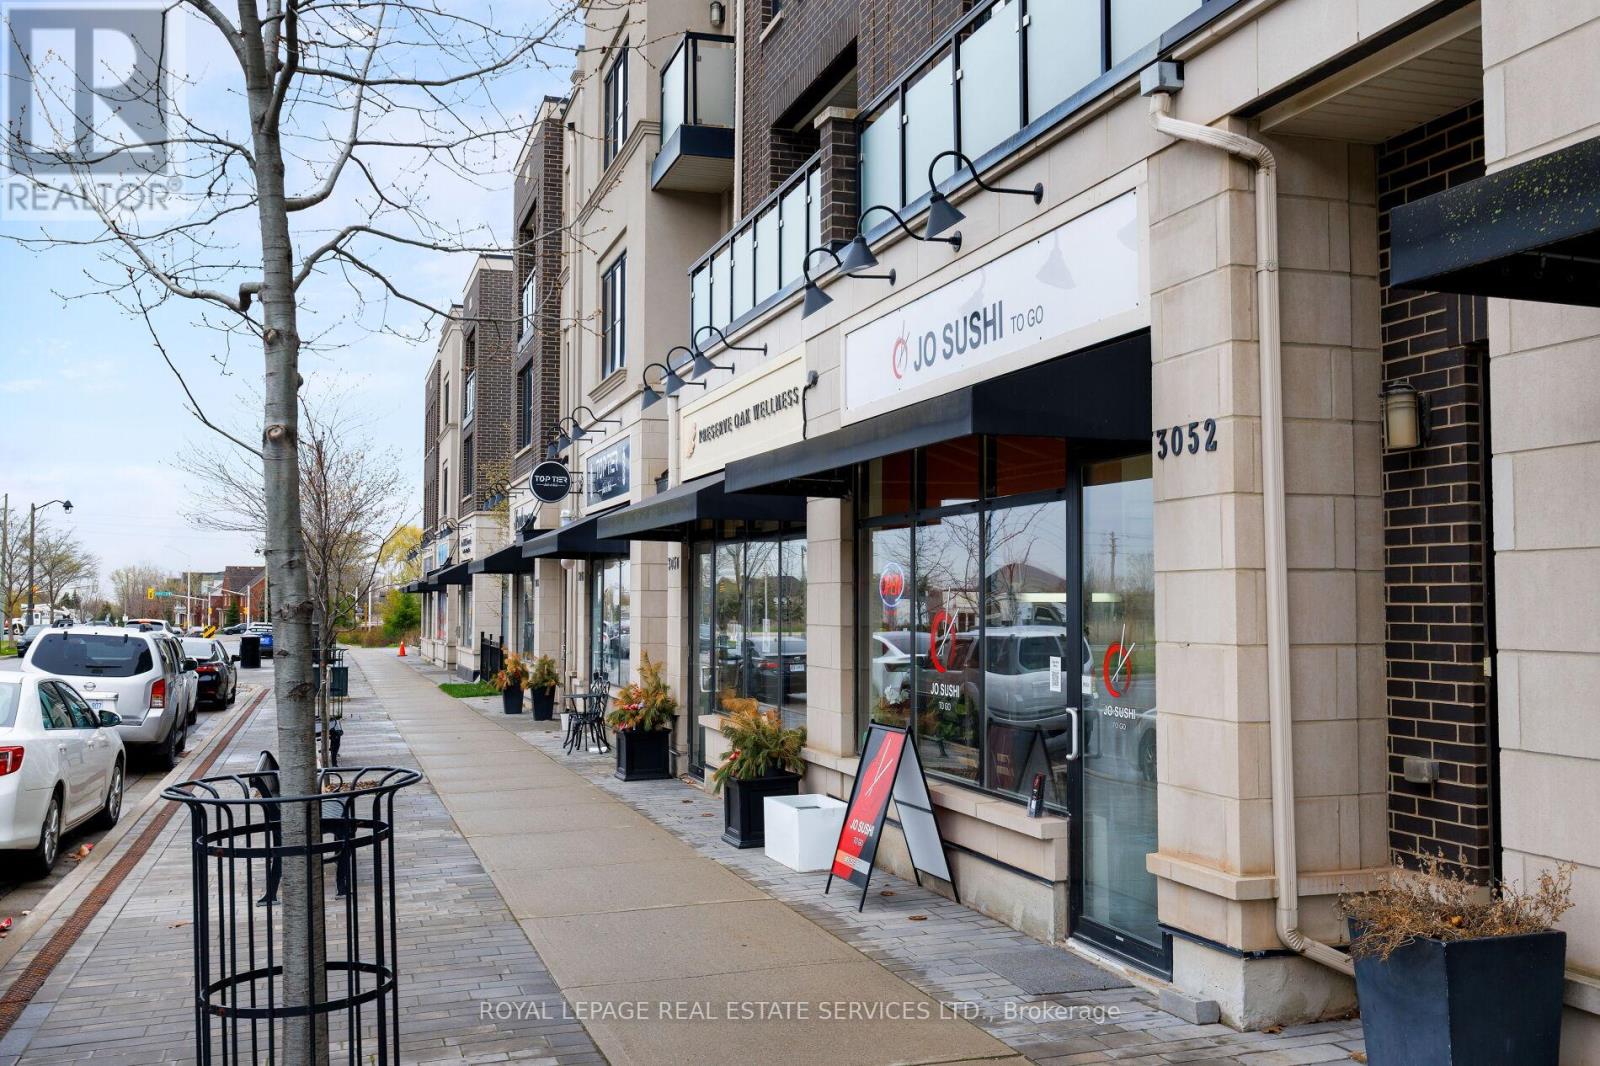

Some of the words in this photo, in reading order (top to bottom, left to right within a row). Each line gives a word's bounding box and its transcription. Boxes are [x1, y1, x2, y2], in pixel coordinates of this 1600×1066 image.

[914, 331, 937, 372] JO
[942, 300, 1003, 360] SUSHI
[1011, 313, 1025, 334] TO
[1027, 305, 1043, 327] GO
[699, 417, 733, 443] PRESERVE
[734, 408, 751, 428] OAK
[753, 386, 799, 420] WELLNESS
[1156, 418, 1217, 460] 3052
[535, 475, 550, 483] TOP
[931, 682, 939, 695] JO
[940, 683, 960, 698] SUSHI
[939, 701, 944, 710] TO
[1104, 704, 1113, 716] JO
[1114, 706, 1136, 719] SUSHI
[850, 819, 859, 831] JO
[858, 820, 875, 837] SUSHI
